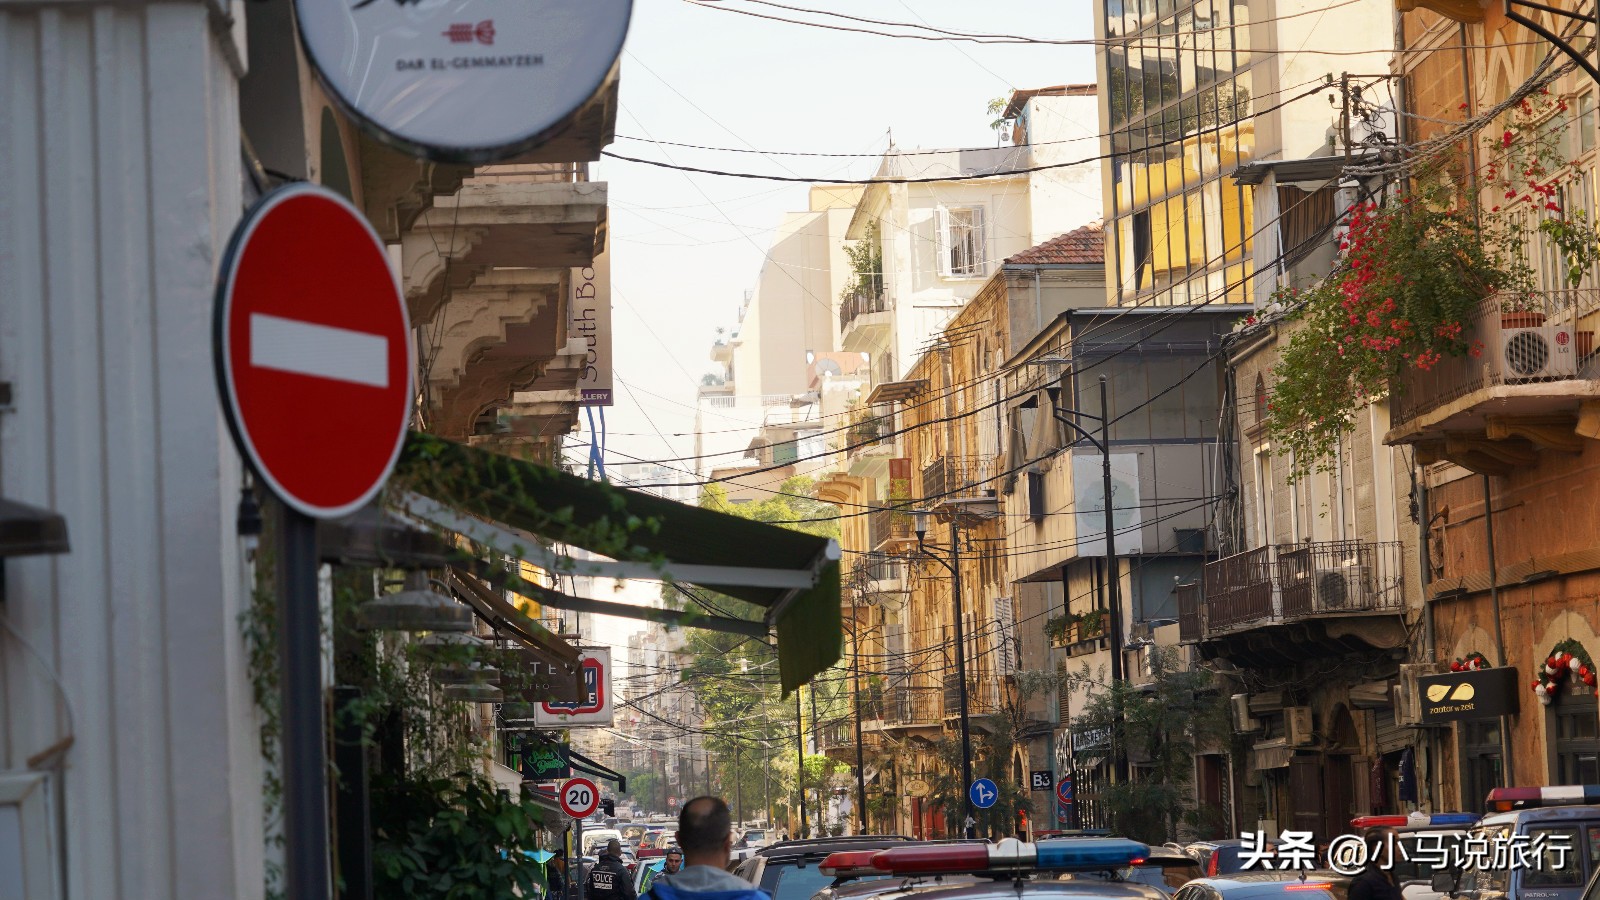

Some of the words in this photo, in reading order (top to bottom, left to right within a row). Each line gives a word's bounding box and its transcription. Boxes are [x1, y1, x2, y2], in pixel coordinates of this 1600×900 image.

[395, 58, 425, 71] DAR
[430, 54, 544, 70] EL-GEMMAYZEH
[575, 261, 596, 300] Bo
[574, 308, 598, 382] South
[568, 789, 590, 806] 20
[592, 873, 613, 884] POLICE
